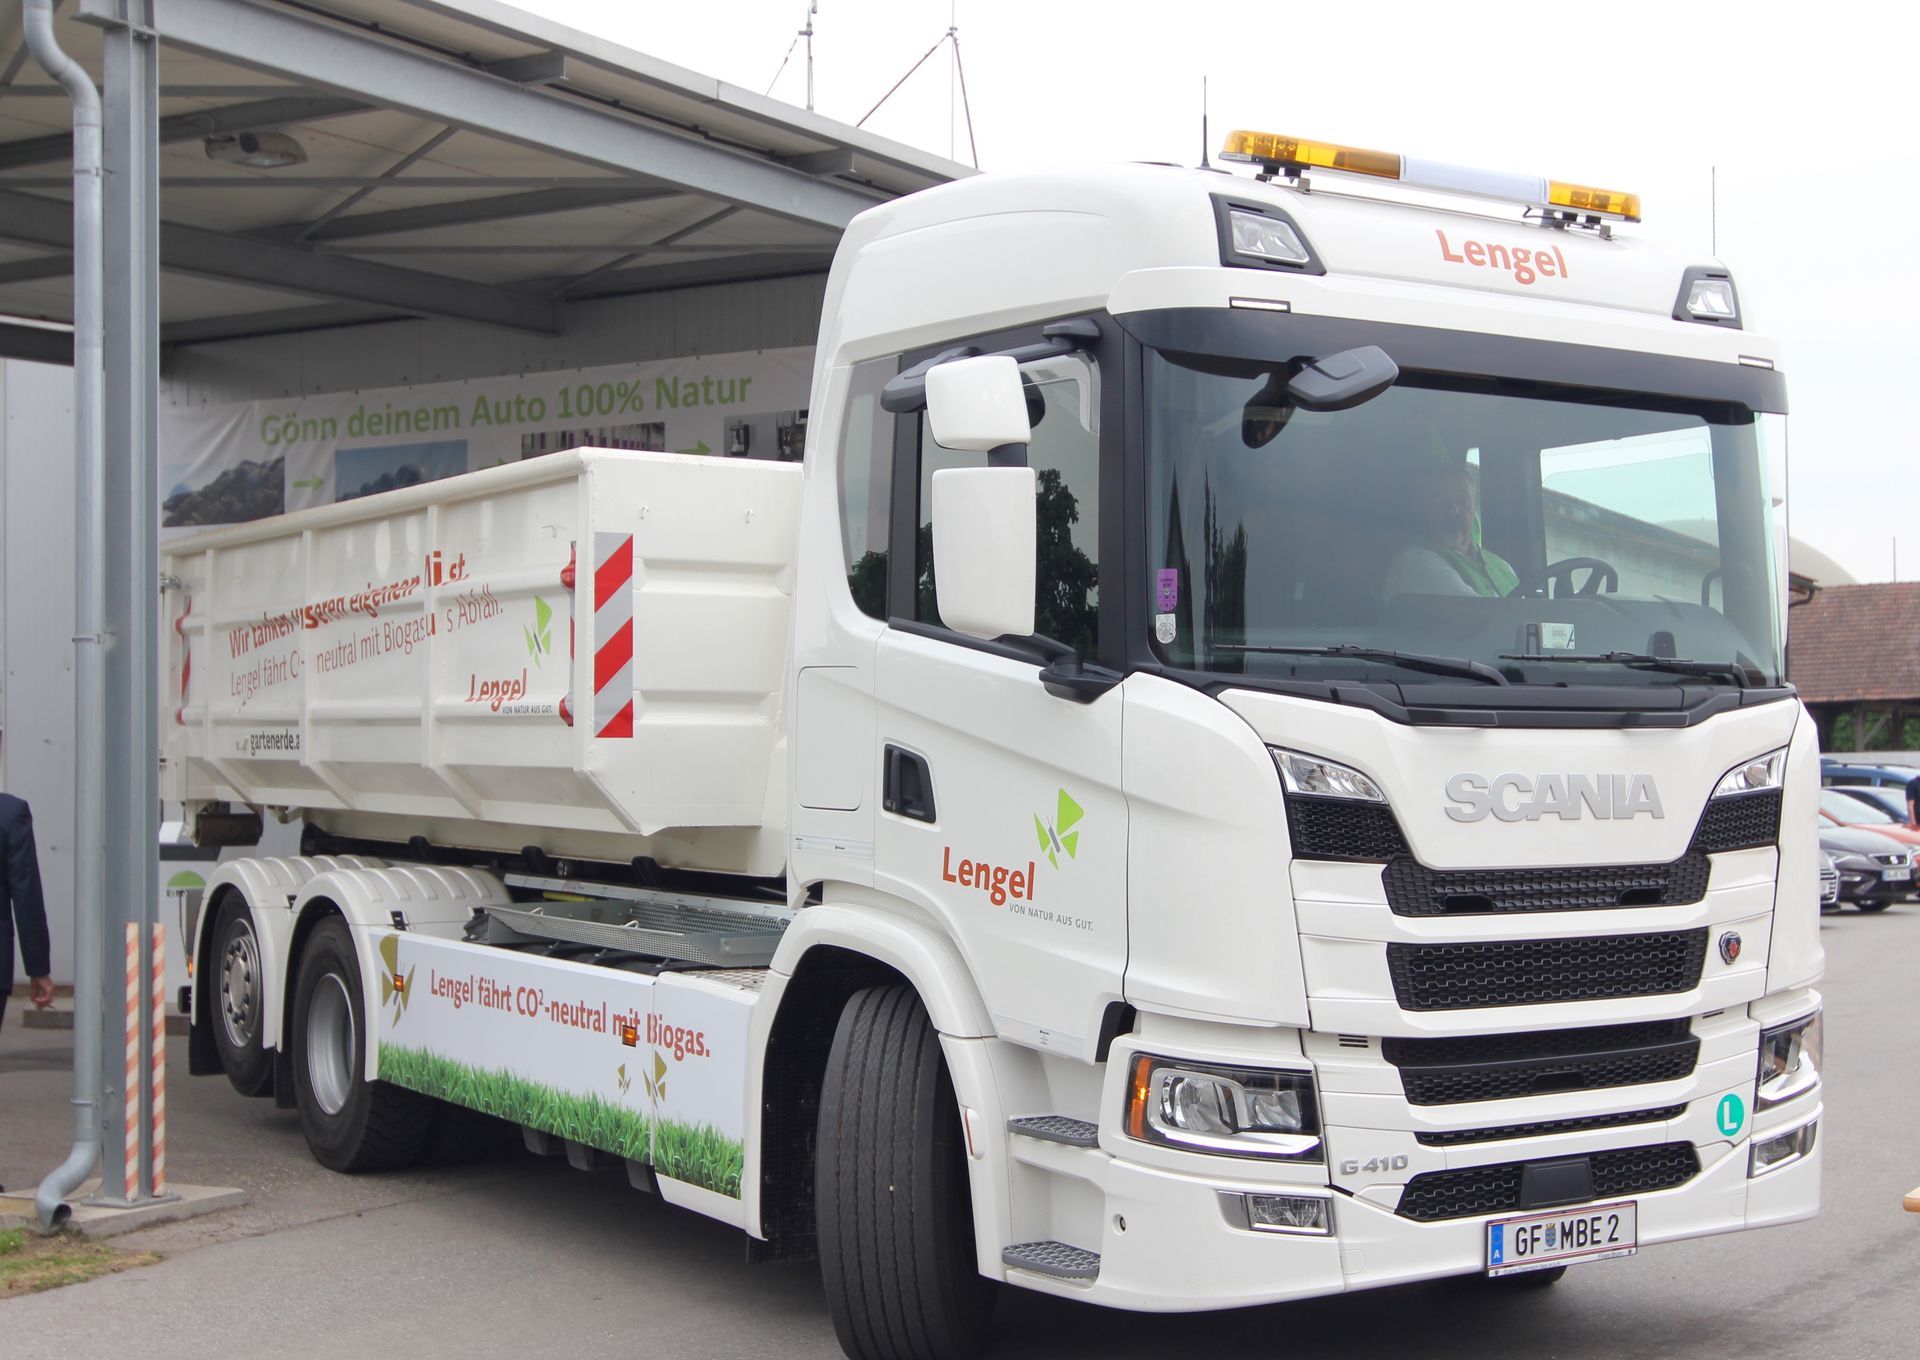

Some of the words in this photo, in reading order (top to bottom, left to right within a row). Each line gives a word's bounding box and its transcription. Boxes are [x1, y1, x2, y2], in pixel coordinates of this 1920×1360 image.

[1435, 229, 1568, 285] Lengel
[261, 412, 337, 446] Gönn
[347, 403, 460, 439] deinem
[470, 394, 546, 427] Auto
[557, 379, 644, 419] 100%
[655, 374, 752, 409] Natur
[229, 626, 249, 659] Wir
[251, 611, 294, 649] tanken
[231, 660, 260, 700] Lengel
[263, 657, 287, 686] fährt
[361, 627, 380, 660] mit
[456, 583, 503, 629] Abfall.
[464, 668, 527, 712] Lengel
[502, 705, 513, 714] VON
[513, 705, 530, 714] NATUR
[531, 705, 541, 714] AUS
[1444, 773, 1665, 822] SCANIA
[942, 846, 1035, 906] Lengel
[1009, 903, 1026, 916] VON
[1028, 907, 1054, 922] NATUR
[1056, 914, 1073, 927] AUS
[1075, 918, 1094, 931] GUT.
[431, 969, 474, 1009] Lengel
[478, 976, 512, 1012] fährt
[612, 1008, 641, 1042] mit
[647, 1013, 710, 1062] Biogas.
[1724, 1101, 1738, 1130] L
[1493, 1249, 1501, 1259] A
[1516, 1224, 1543, 1256] GF
[1561, 1216, 1602, 1250] MBE
[1607, 1214, 1619, 1243] 2
